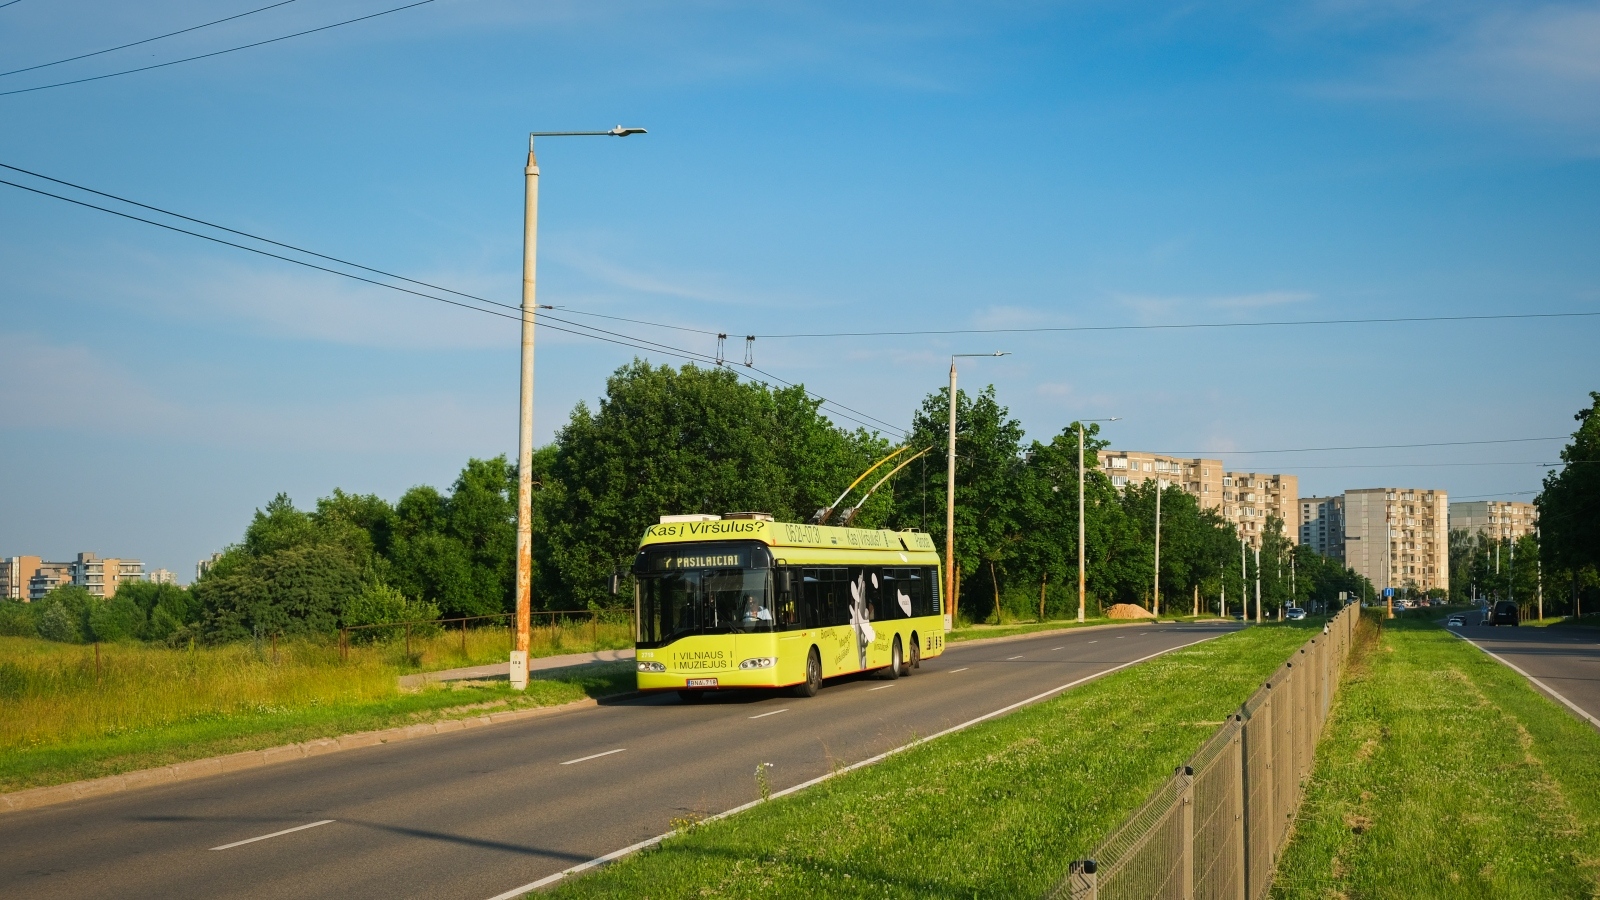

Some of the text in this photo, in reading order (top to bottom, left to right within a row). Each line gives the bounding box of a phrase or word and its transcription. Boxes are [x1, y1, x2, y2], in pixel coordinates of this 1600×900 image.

[646, 525, 676, 537] Kas
[689, 521, 765, 534] Viršulus?
[664, 555, 739, 568] 7 PASILAICIAI
[679, 651, 723, 660] VILNIAUS
[679, 660, 727, 669] MUZIEJUS
